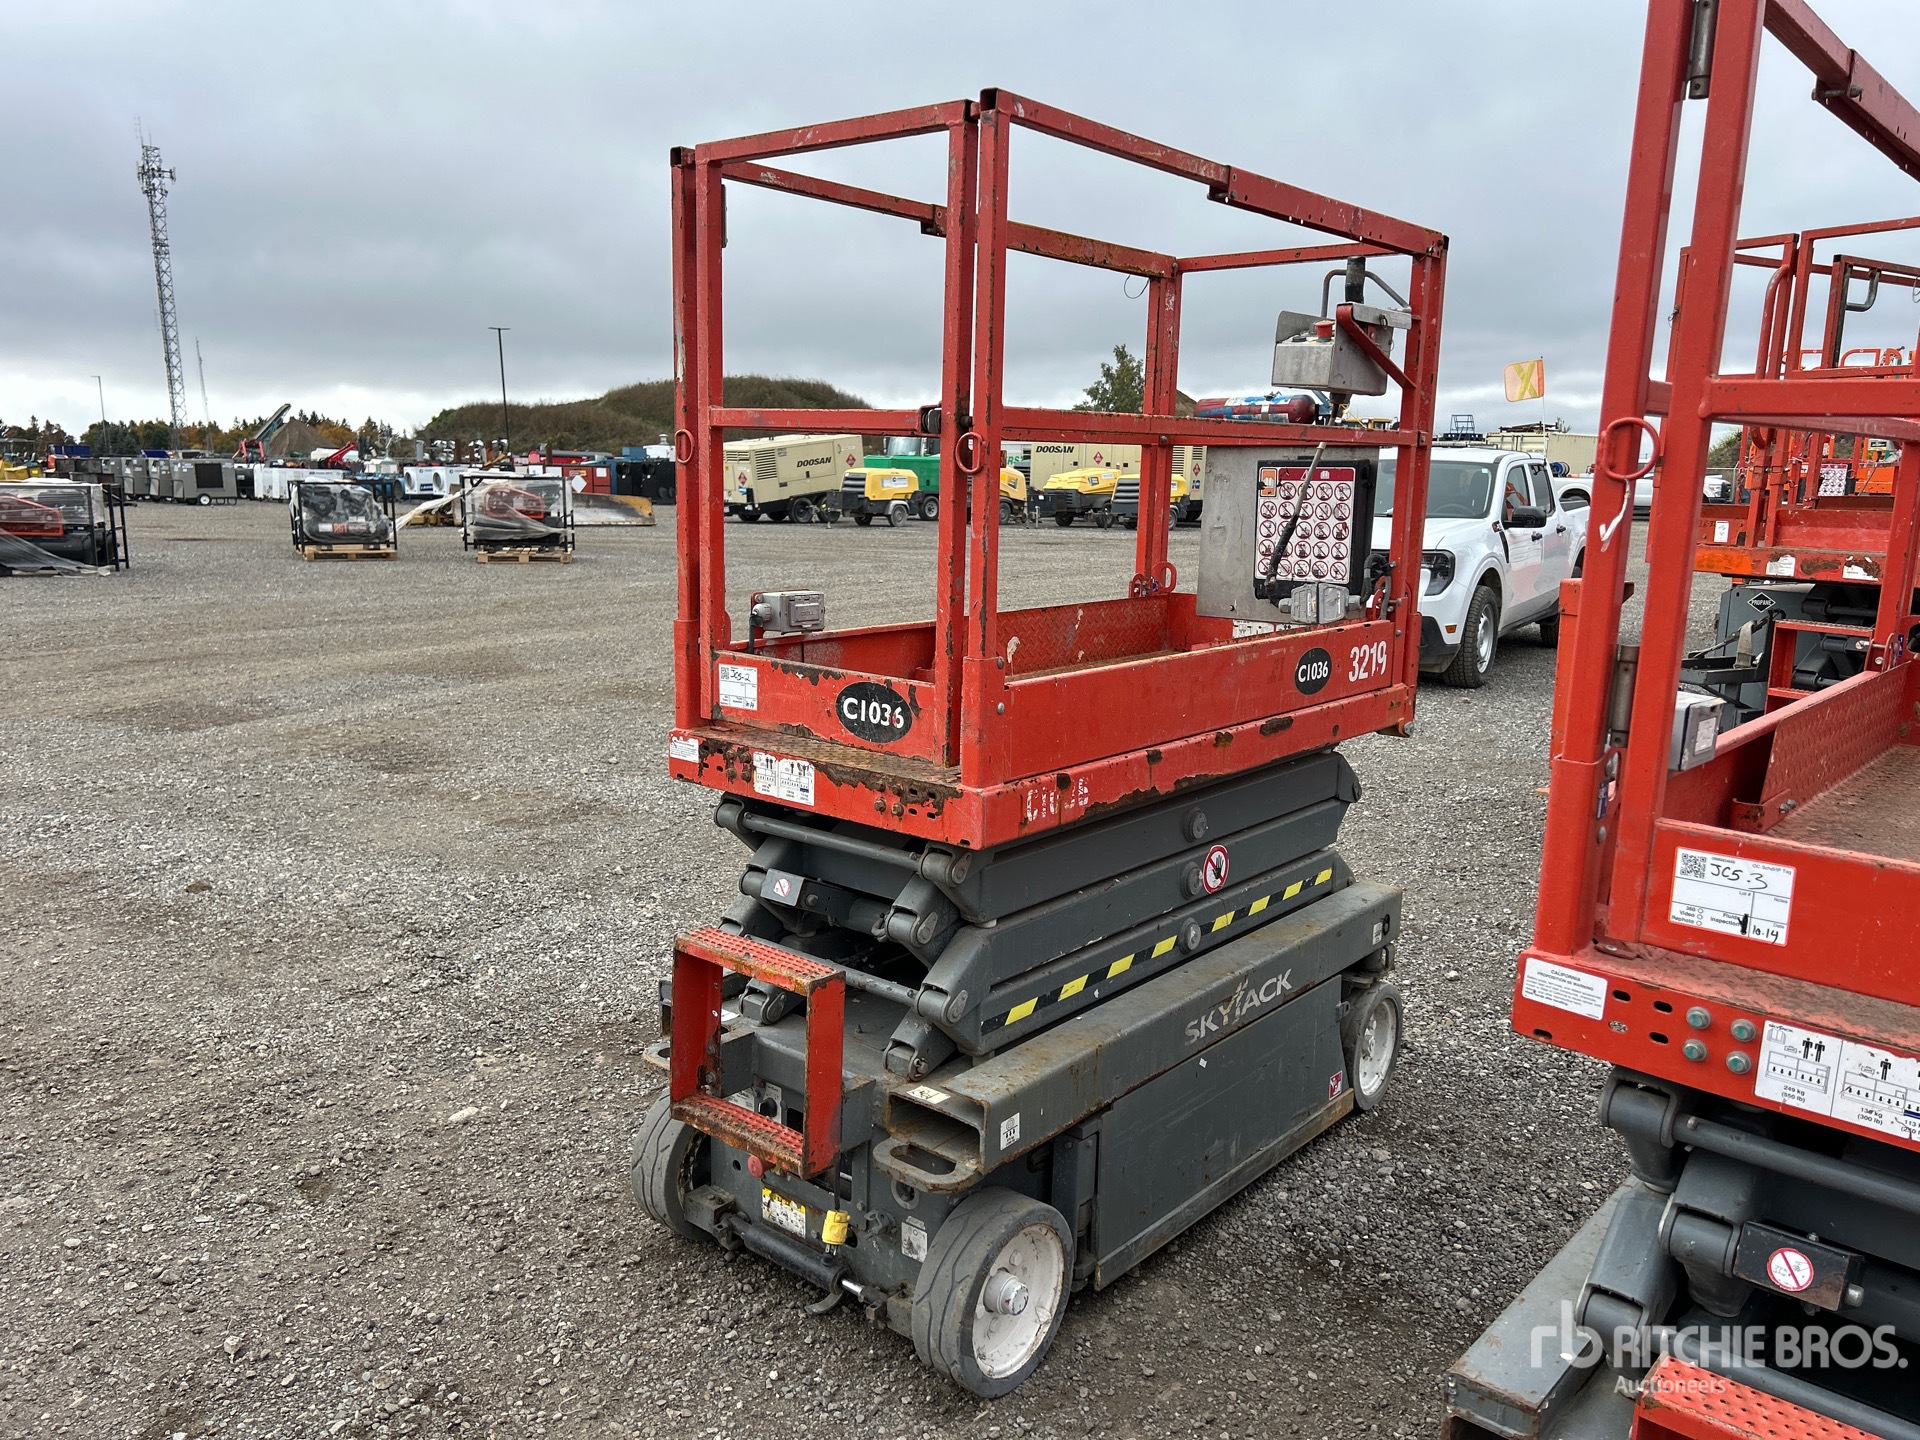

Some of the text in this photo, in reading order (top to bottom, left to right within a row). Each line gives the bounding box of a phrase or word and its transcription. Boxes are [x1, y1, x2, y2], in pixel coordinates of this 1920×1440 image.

[1035, 445, 1075, 454] DOOSAN
[796, 456, 832, 468] DOOSAN
[1348, 640, 1387, 682] 3219
[1550, 969, 1581, 982] CALIFORNIA
[1184, 967, 1293, 1046] SKYJACK
[1783, 1085, 1806, 1097] 249 kg
[1857, 1113, 1872, 1123] (300
[1873, 1109, 1883, 1119] kg
[1904, 1119, 1917, 1127] 113
